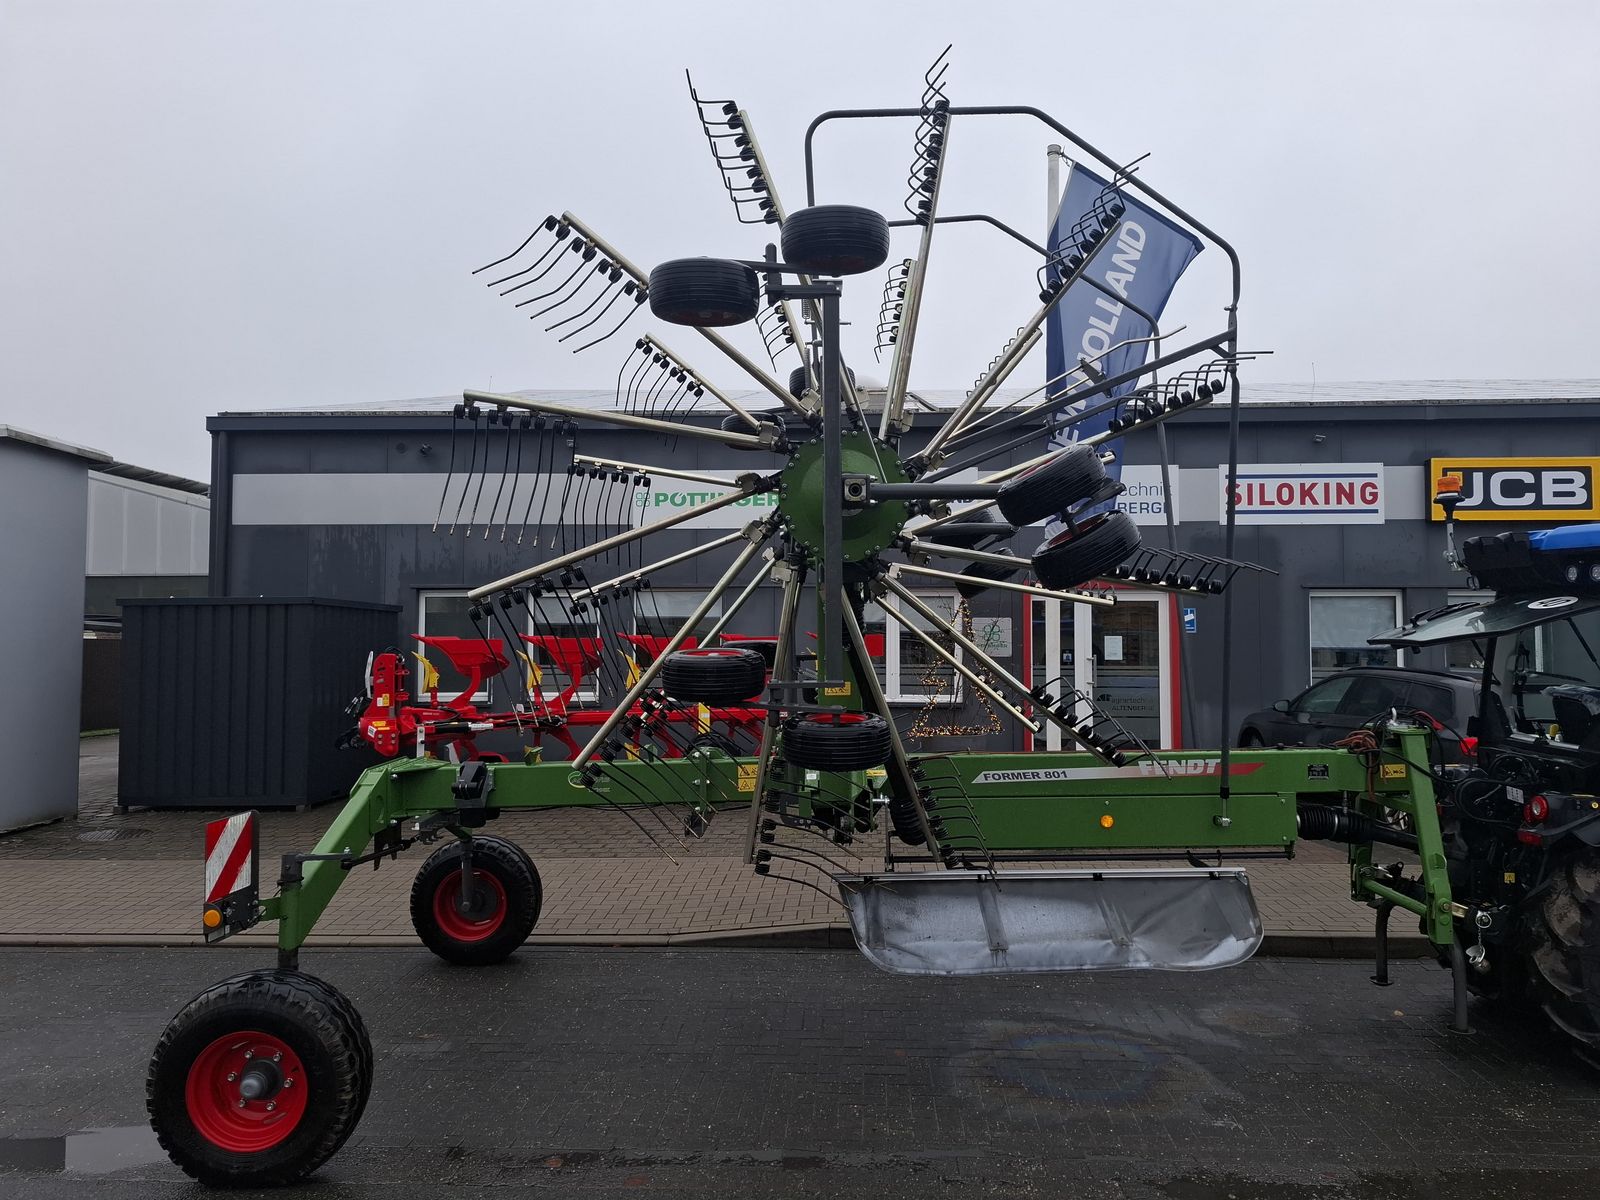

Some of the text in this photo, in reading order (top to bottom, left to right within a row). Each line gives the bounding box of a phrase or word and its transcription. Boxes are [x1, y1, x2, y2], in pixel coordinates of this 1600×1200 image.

[1225, 481, 1380, 506] SILOKING
[1455, 470, 1588, 507] JCB
[654, 492, 780, 507] PÖTTGER
[983, 769, 1068, 782] FORMER 801
[1138, 758, 1222, 776] FENDT
